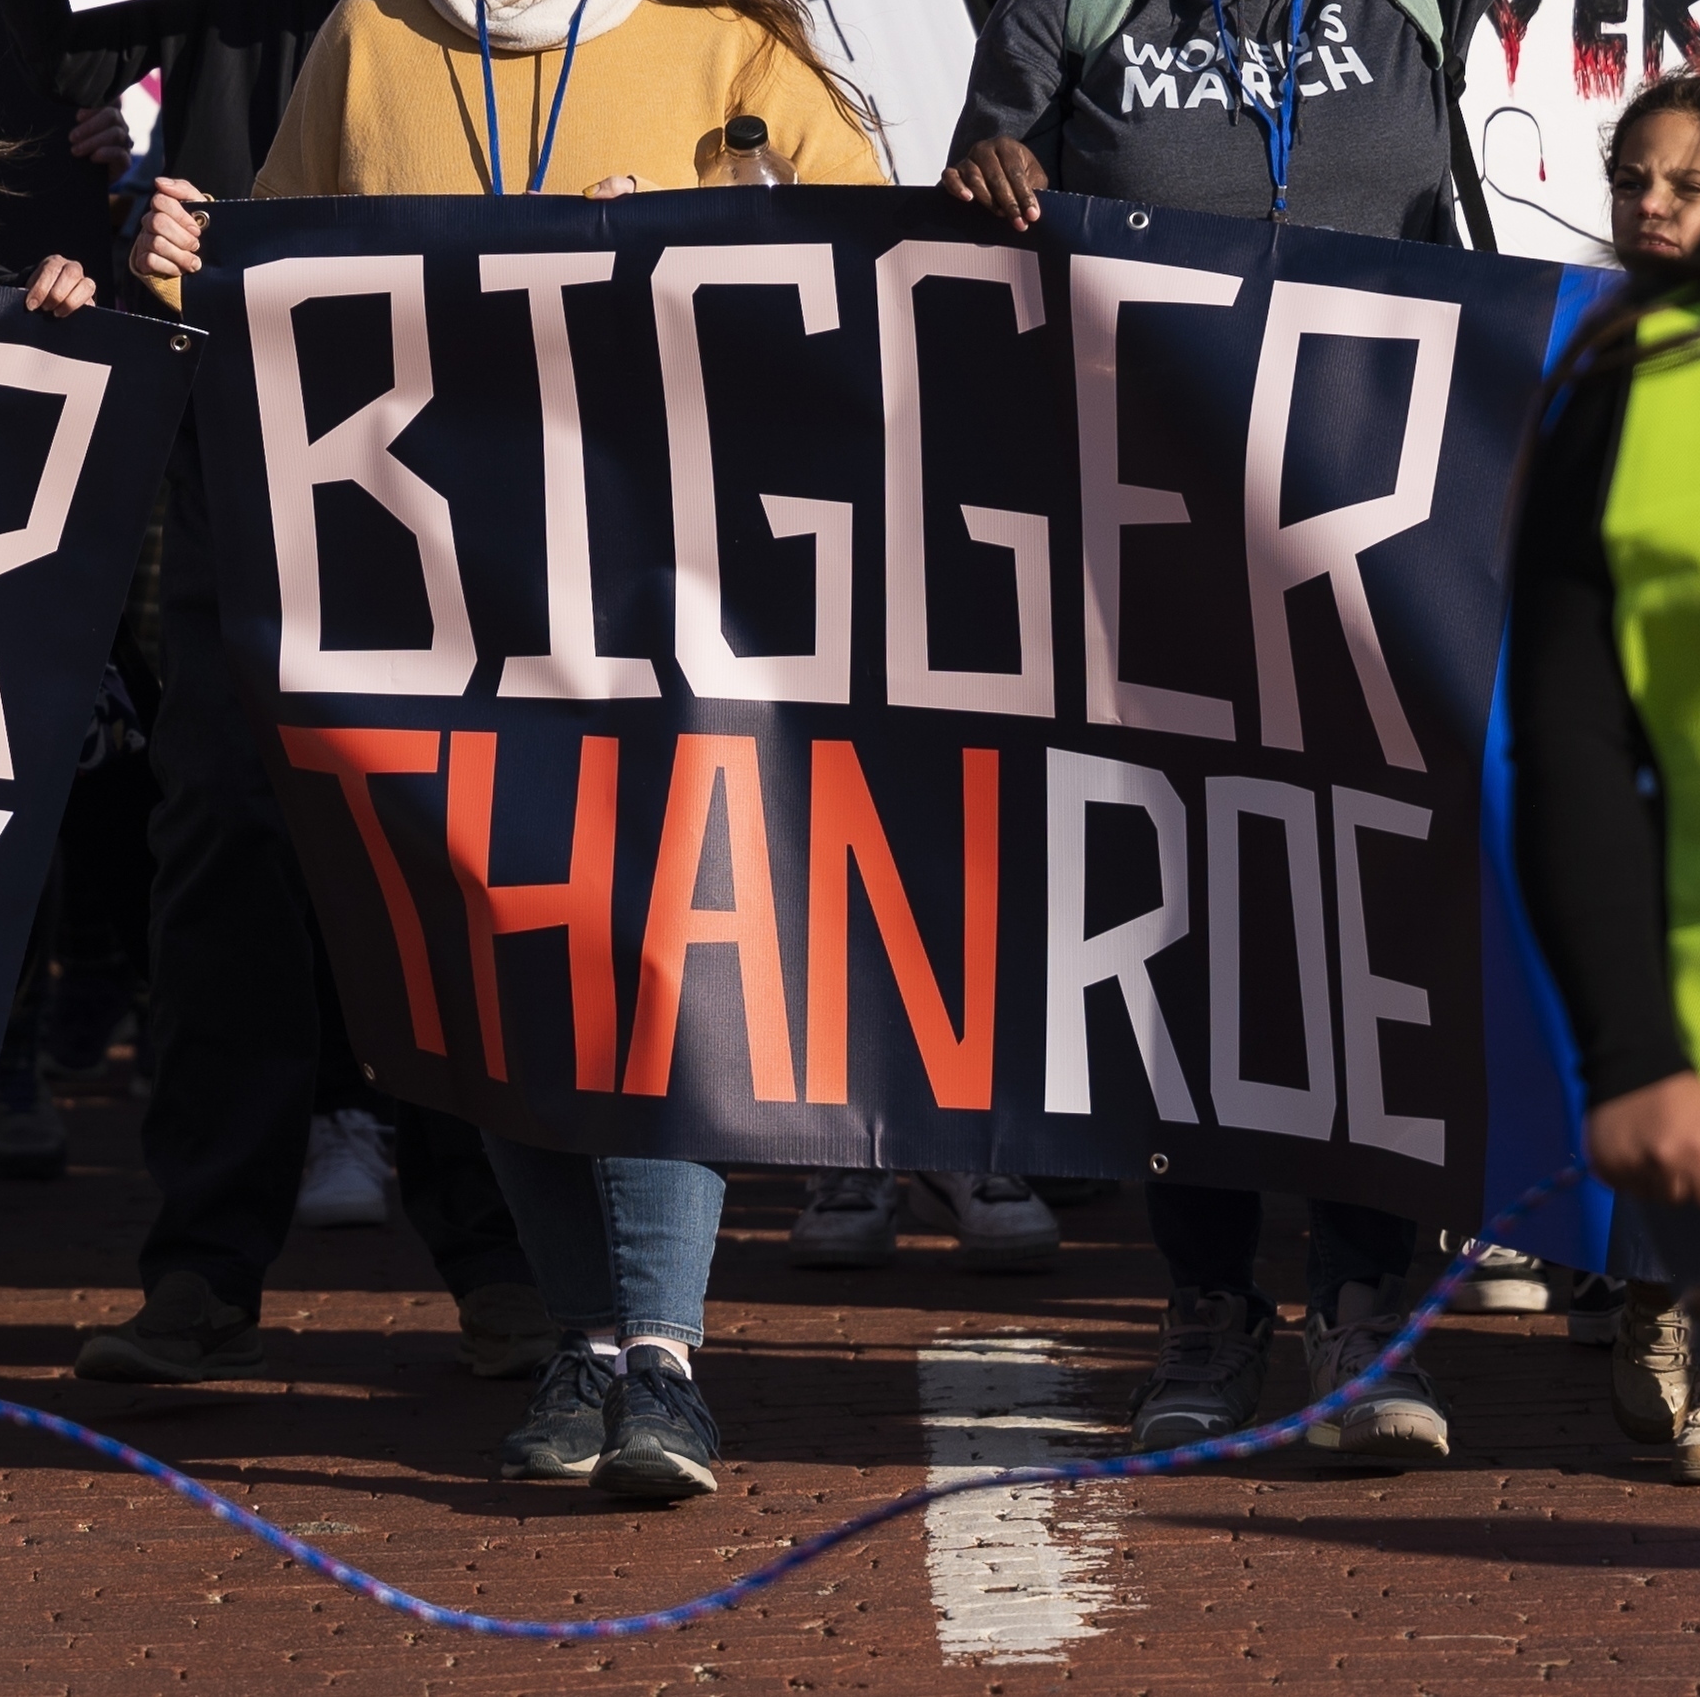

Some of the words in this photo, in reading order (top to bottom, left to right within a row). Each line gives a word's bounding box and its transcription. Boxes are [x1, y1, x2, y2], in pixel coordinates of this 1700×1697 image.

[243, 239, 1462, 773] BIGGER
[278, 724, 1000, 1111] THAN
[1044, 746, 1447, 1167] ROE
